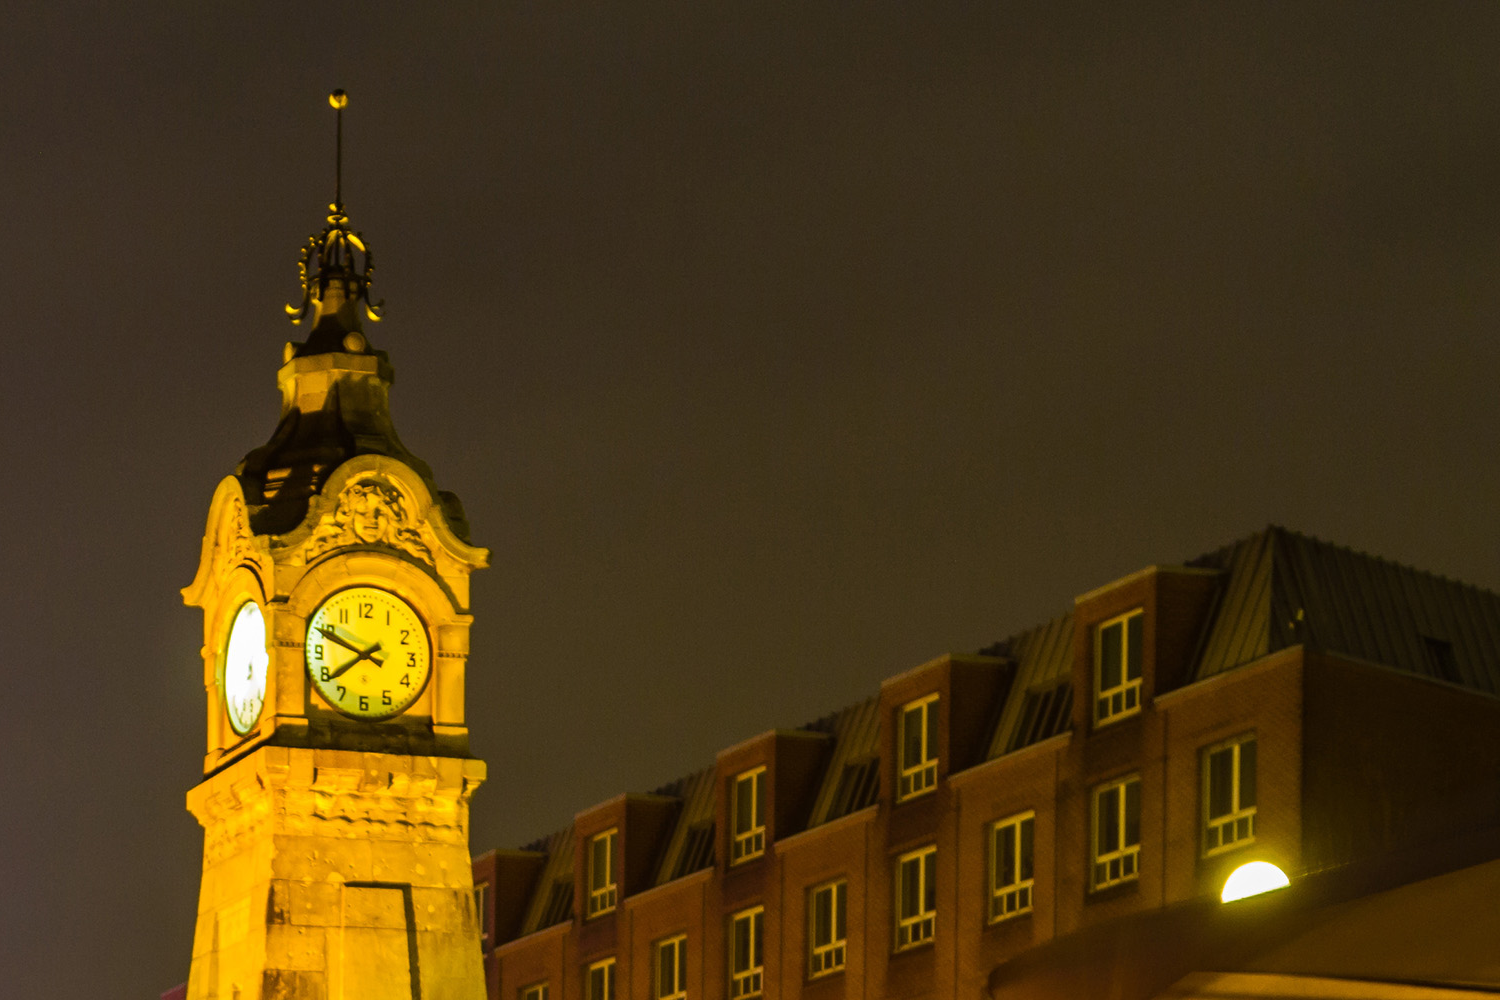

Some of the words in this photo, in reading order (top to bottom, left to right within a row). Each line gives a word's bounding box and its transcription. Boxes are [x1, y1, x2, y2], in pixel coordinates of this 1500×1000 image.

[339, 608, 349, 624] 11
[358, 603, 373, 619] 12
[400, 630, 410, 645] 2
[314, 644, 323, 661] 9
[406, 652, 416, 668] 3
[320, 666, 330, 682] 8
[400, 673, 410, 688] 4
[336, 685, 347, 702] 7
[381, 690, 392, 706] 5
[359, 695, 369, 711] 6
